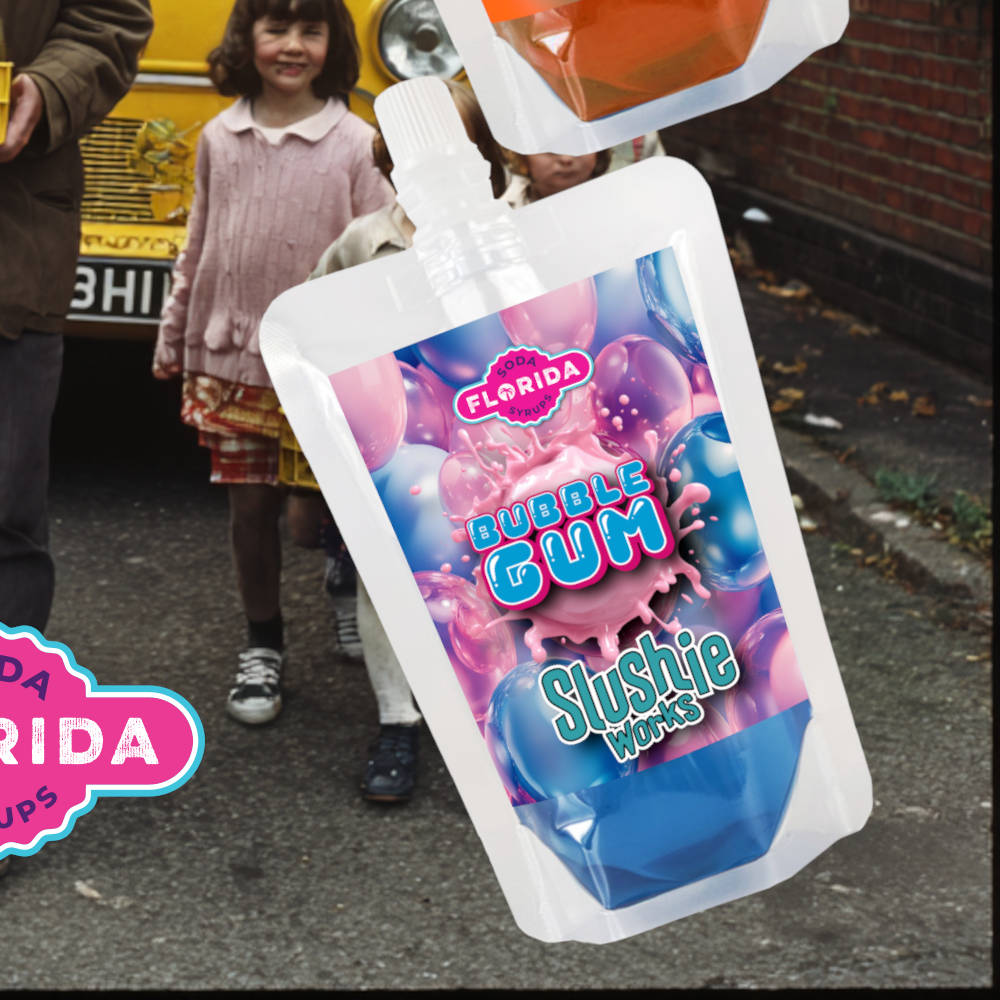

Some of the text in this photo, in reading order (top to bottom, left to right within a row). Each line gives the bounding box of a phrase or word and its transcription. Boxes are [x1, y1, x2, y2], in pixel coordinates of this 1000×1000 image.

[465, 359, 581, 415] FLORIDA
[497, 355, 537, 379] SODA
[508, 393, 553, 418] SYRUPS
[465, 460, 653, 552] BUBBLE
[484, 495, 668, 606] GUM
